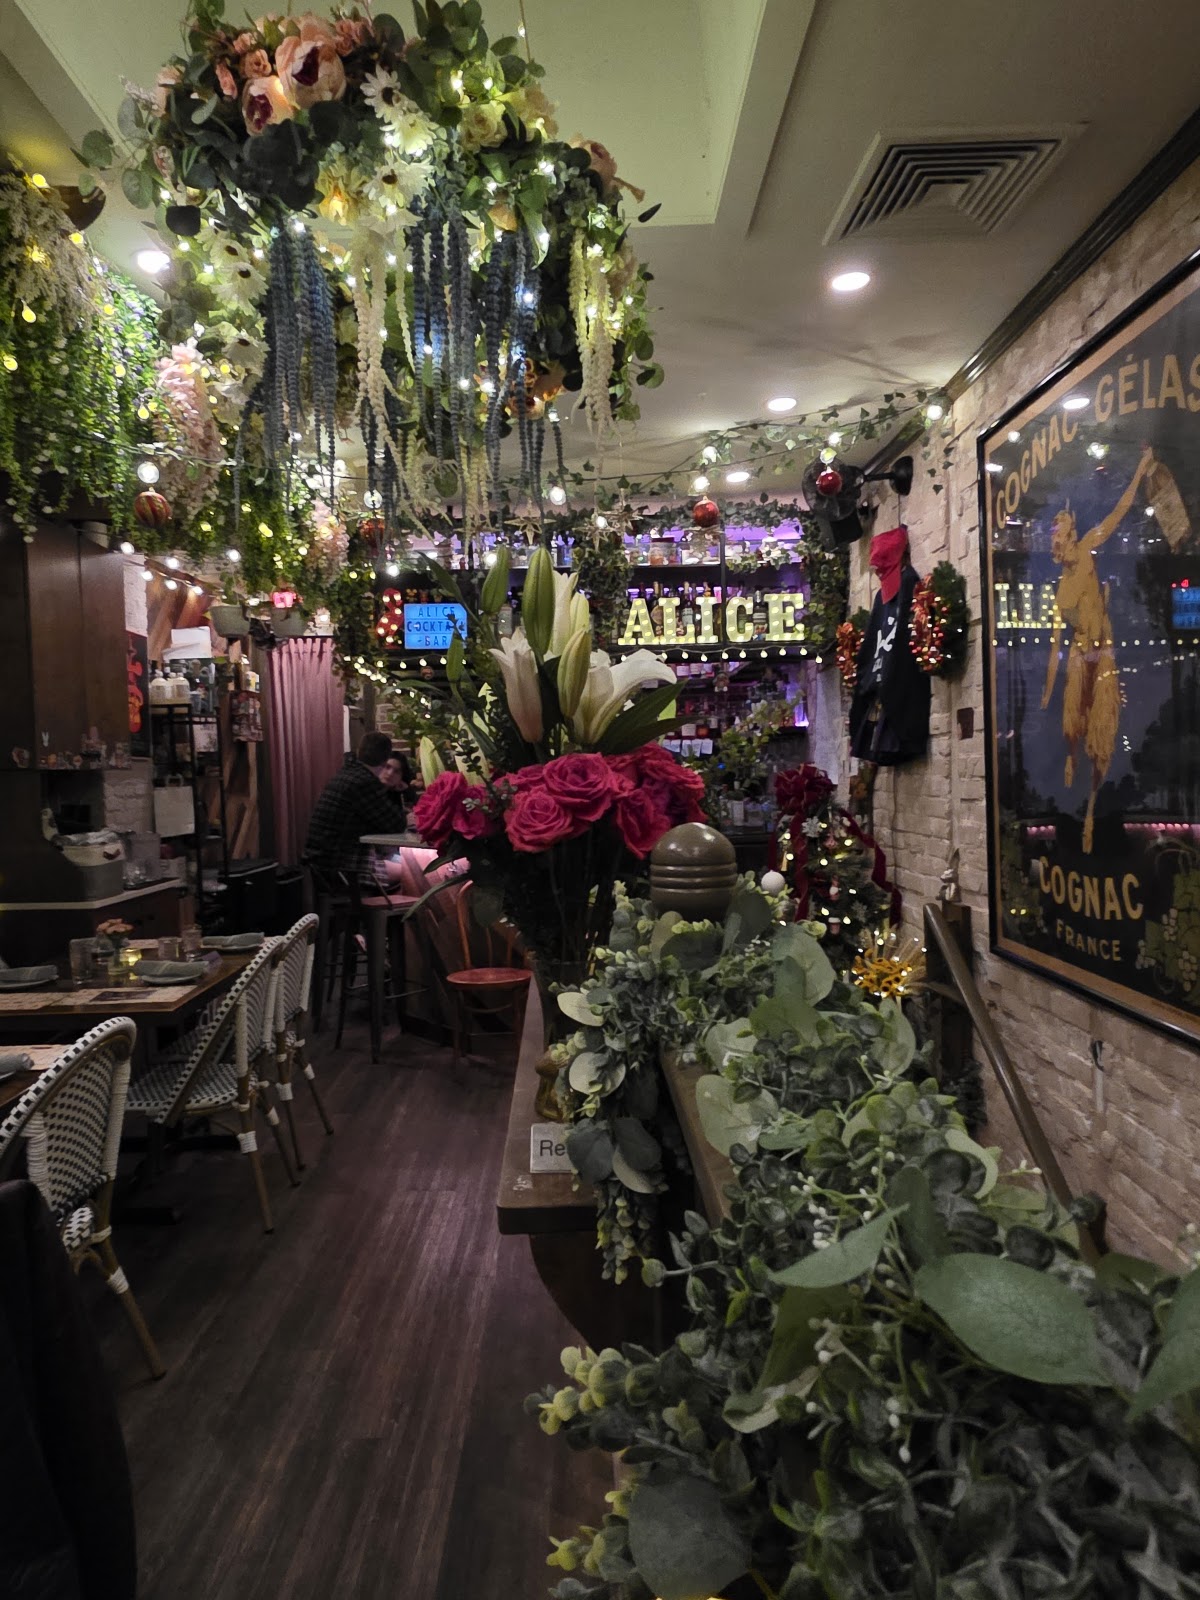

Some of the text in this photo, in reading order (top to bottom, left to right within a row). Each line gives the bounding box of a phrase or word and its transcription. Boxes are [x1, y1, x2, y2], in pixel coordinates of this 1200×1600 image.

[996, 410, 1079, 529] COGNAC
[406, 620, 465, 632] COCKTAL
[418, 606, 455, 618] ALICE
[617, 593, 805, 646] ALICE
[1039, 855, 1144, 920] COGNAC
[1056, 918, 1122, 962] FRANCE
